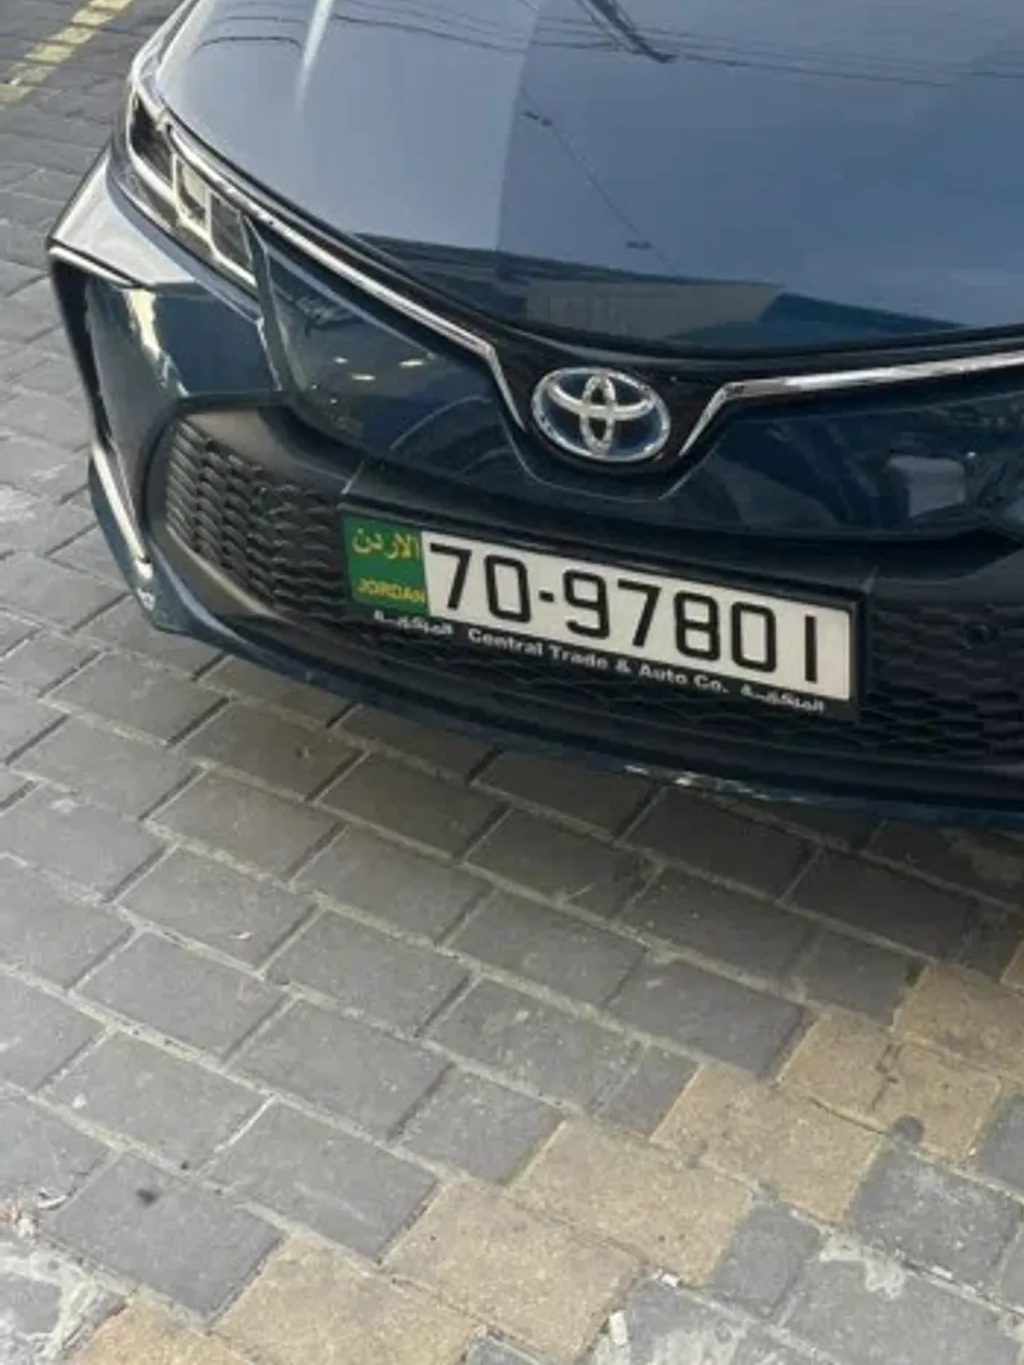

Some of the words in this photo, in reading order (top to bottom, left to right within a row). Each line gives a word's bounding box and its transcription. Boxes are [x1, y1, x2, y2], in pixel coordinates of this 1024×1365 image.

[357, 577, 426, 603] JORDAN
[428, 542, 818, 684] 70-97801
[467, 628, 543, 657] Central
[549, 644, 609, 670] Trade
[615, 658, 632, 674] &
[638, 664, 688, 686] Auto
[693, 674, 730, 694] Co.
